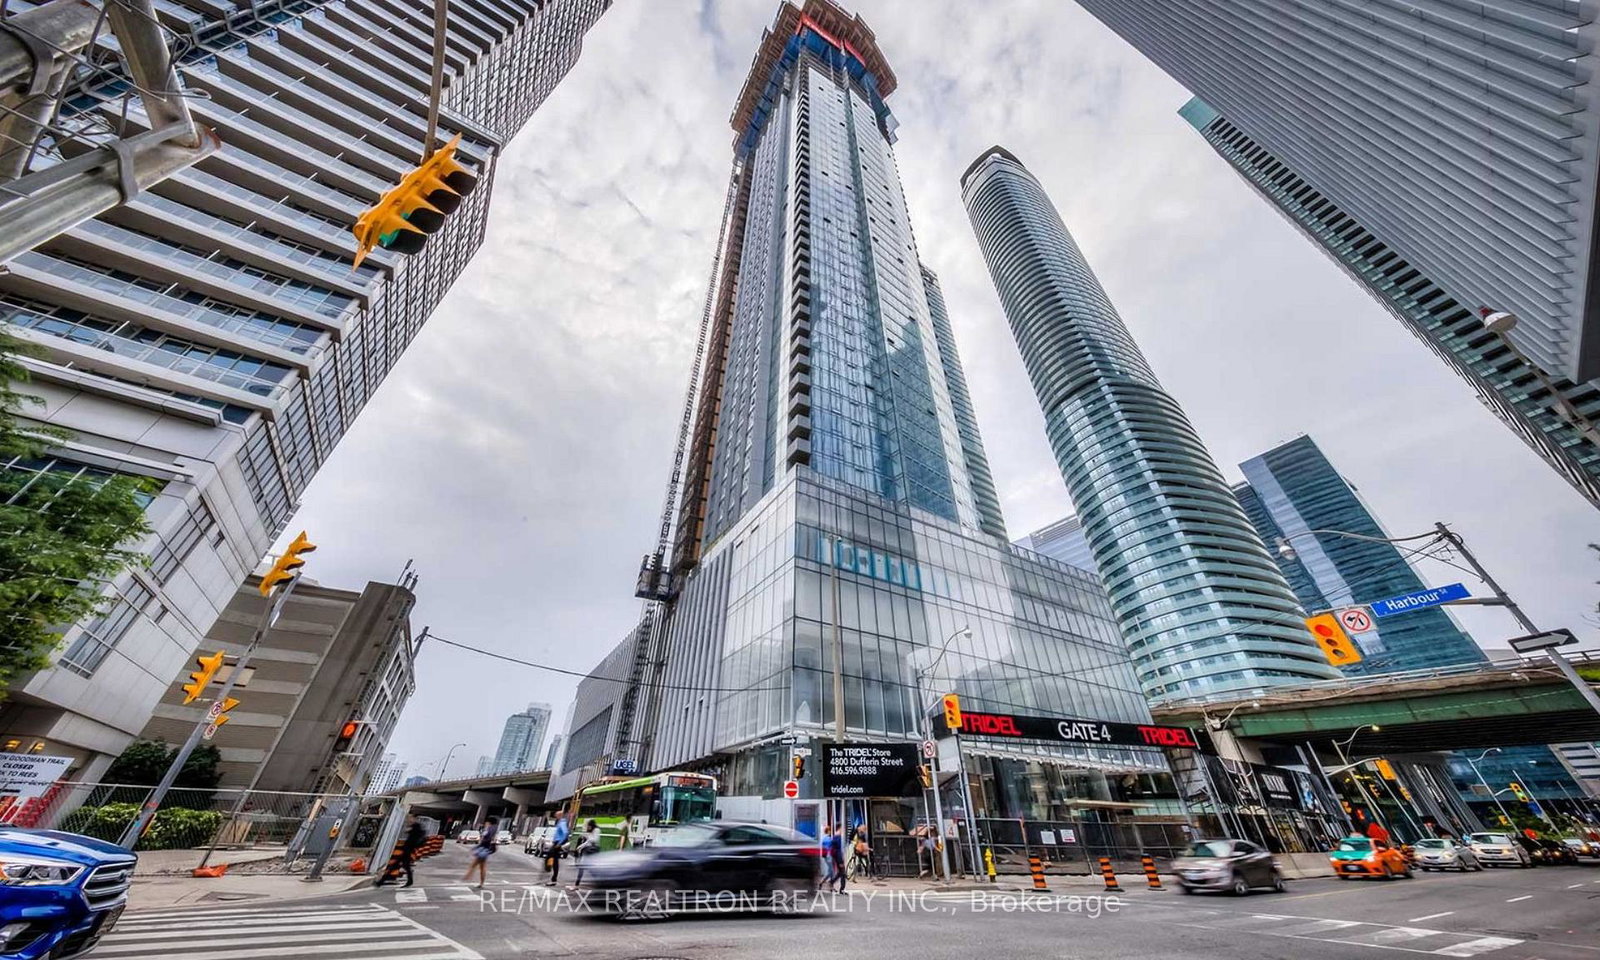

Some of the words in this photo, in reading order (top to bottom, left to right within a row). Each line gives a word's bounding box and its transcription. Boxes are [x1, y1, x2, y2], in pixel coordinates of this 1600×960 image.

[1385, 592, 1440, 610] Harbour
[961, 713, 1022, 736] TRIDEL
[1057, 721, 1100, 741] GATE
[1100, 724, 1111, 741] 4
[1137, 726, 1195, 746] TRIDEL
[830, 748, 843, 756] The
[843, 748, 871, 757] TRIDEL
[872, 748, 891, 756] Store
[2, 762, 34, 770] CLOSED
[830, 758, 848, 766] 4800
[850, 757, 879, 766] Dufferin
[881, 758, 903, 766] Street
[830, 766, 877, 775] 416.596.9888
[831, 785, 863, 793] tridel.com
